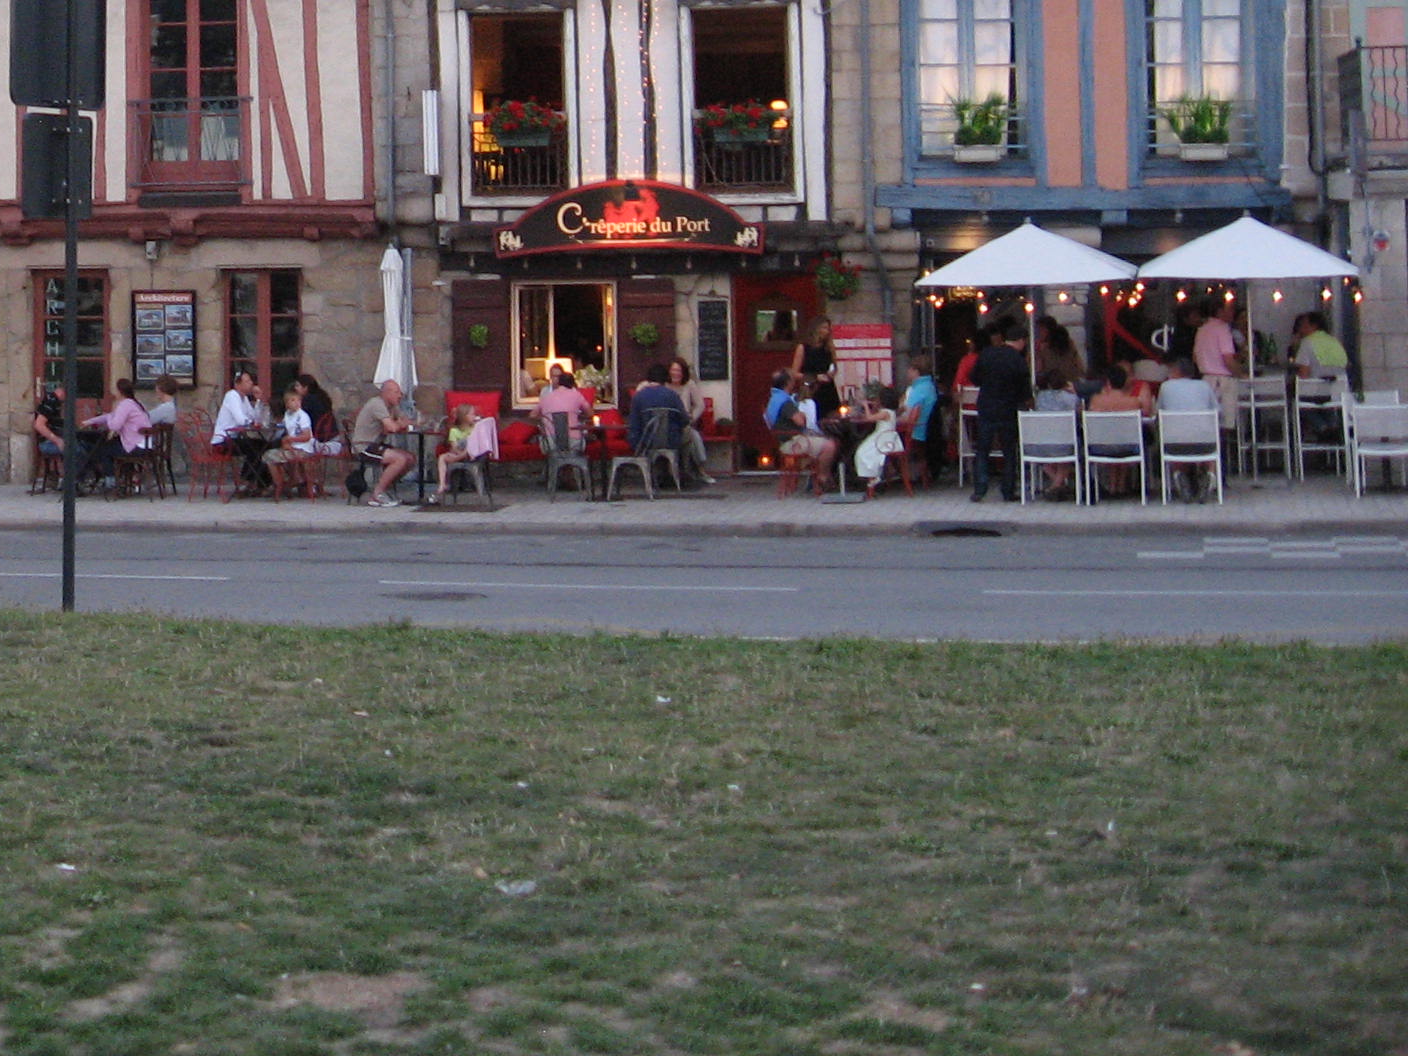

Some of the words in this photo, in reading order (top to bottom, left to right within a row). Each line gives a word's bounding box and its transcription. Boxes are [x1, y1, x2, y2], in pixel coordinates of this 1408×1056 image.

[557, 202, 646, 238] Crêperie
[649, 216, 672, 233] du
[675, 216, 711, 233] Port
